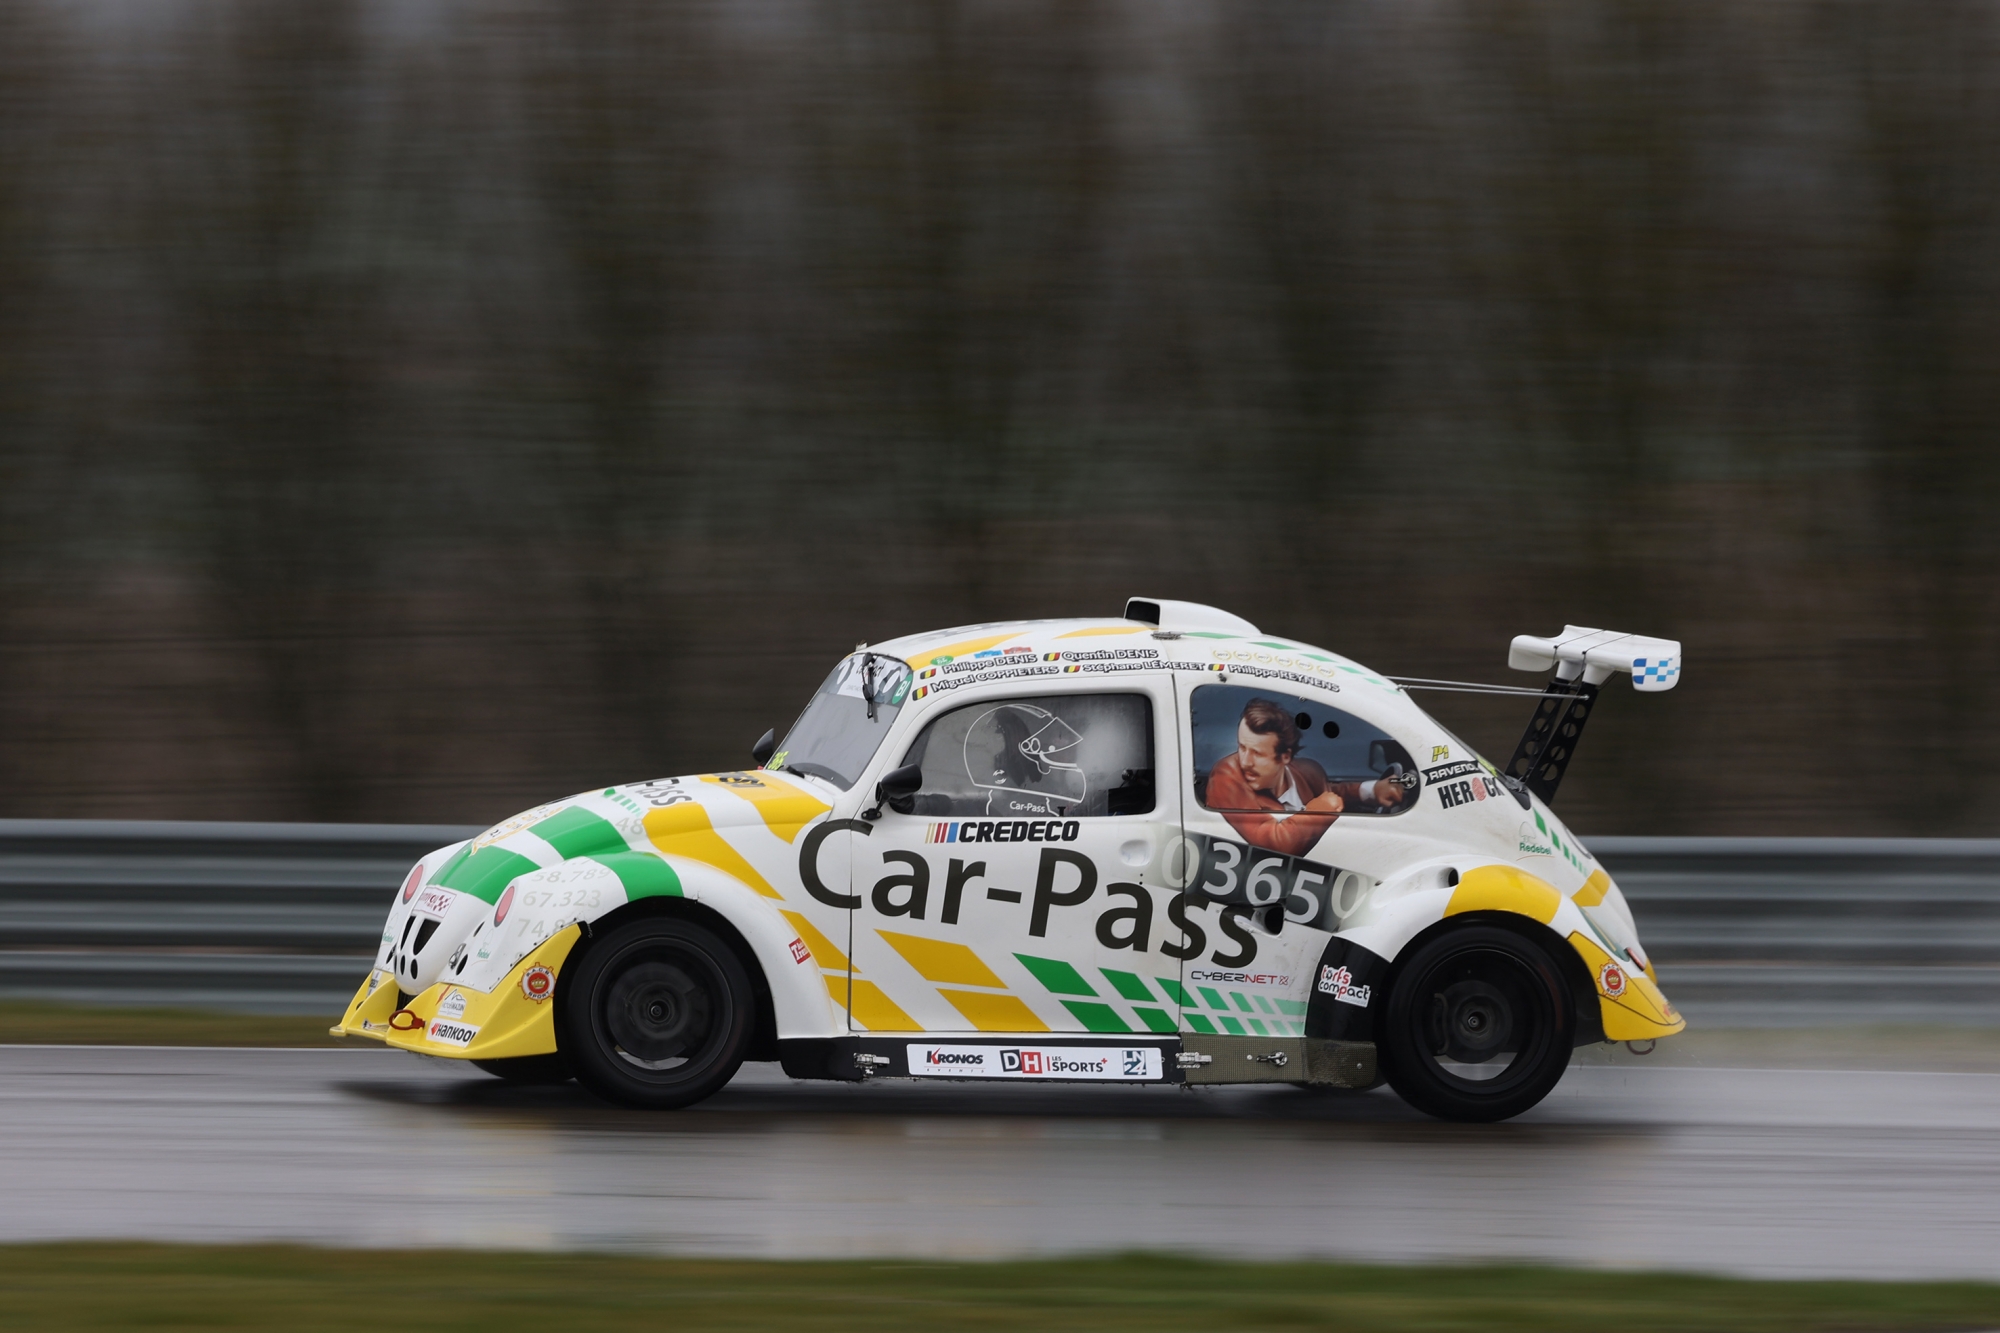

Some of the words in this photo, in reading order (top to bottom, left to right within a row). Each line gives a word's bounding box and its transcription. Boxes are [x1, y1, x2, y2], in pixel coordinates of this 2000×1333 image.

[941, 660, 994, 675] Philippe
[994, 653, 1039, 667] DENIS
[1061, 649, 1115, 662] Quentin
[1115, 648, 1159, 660] DENIS
[930, 674, 977, 694] Miguel
[976, 665, 1060, 681] COPPIETERS
[1227, 663, 1280, 679] Philippe
[1278, 669, 1340, 693] REYNENS
[1009, 800, 1046, 813] Car-Pass
[958, 820, 1080, 843] CREDECO
[1519, 842, 1553, 856] Redebel
[1160, 833, 1369, 926] 03650
[522, 889, 602, 909] 67.323
[798, 819, 1259, 969] Car-Pass
[1321, 966, 1350, 985] torfs
[1319, 981, 1369, 1000] compact
[926, 1047, 984, 1065] KRONOS
